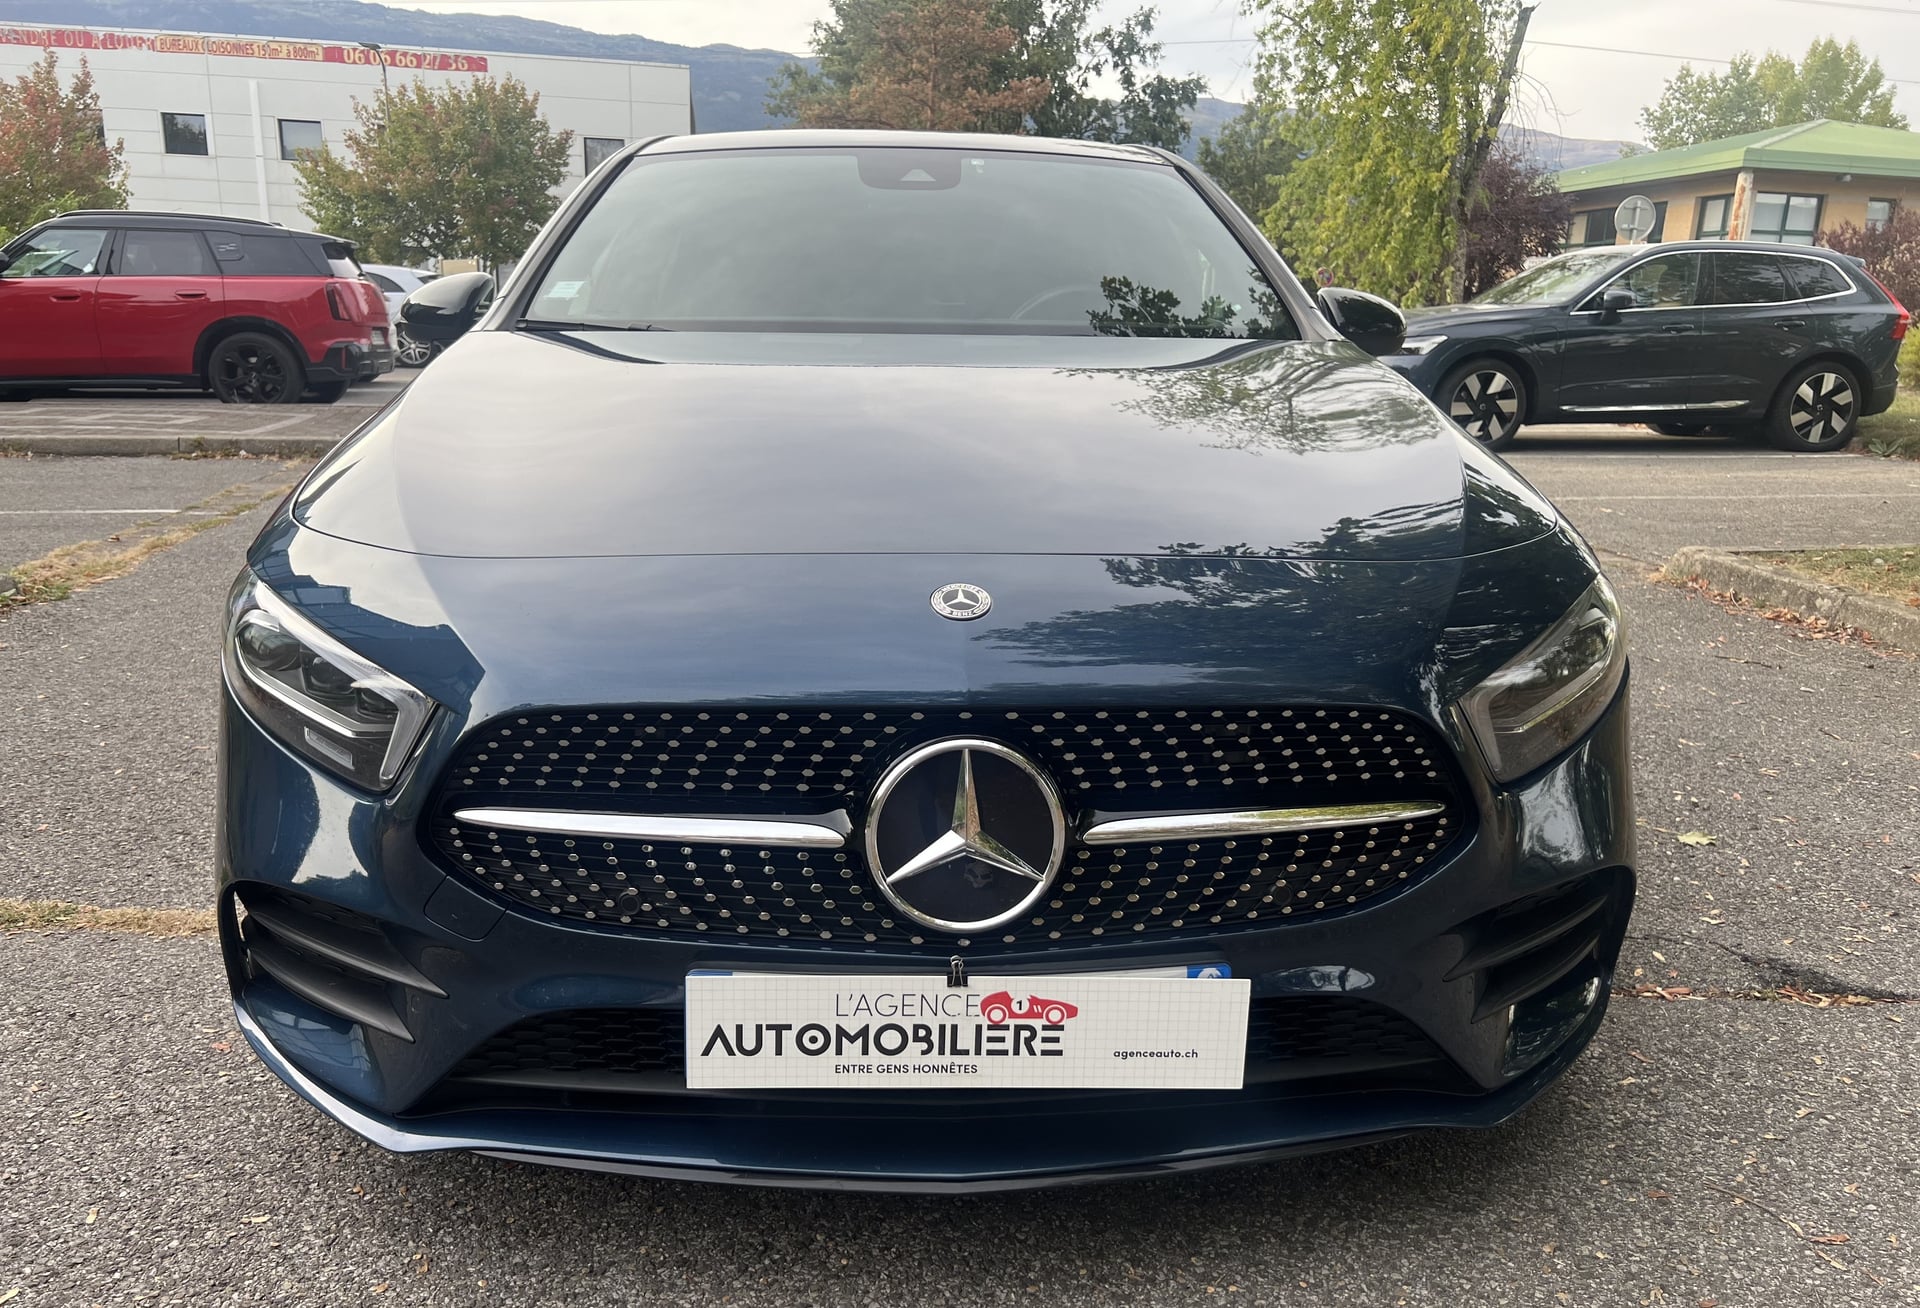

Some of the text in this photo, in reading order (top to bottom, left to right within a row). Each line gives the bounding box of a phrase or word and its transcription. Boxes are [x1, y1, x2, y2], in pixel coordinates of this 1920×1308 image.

[64, 31, 84, 47] OU
[160, 37, 199, 52] BUREAUX
[343, 47, 365, 64] 06
[370, 49, 391, 66] 06
[395, 51, 417, 67] 66
[423, 53, 441, 70] 27
[836, 993, 980, 1017] L'AGENCE
[1016, 1000, 1023, 1011] 1
[1113, 1049, 1199, 1060] agenceauto.ch
[835, 1061, 978, 1074] ENTRE GENS HONNÊTES
